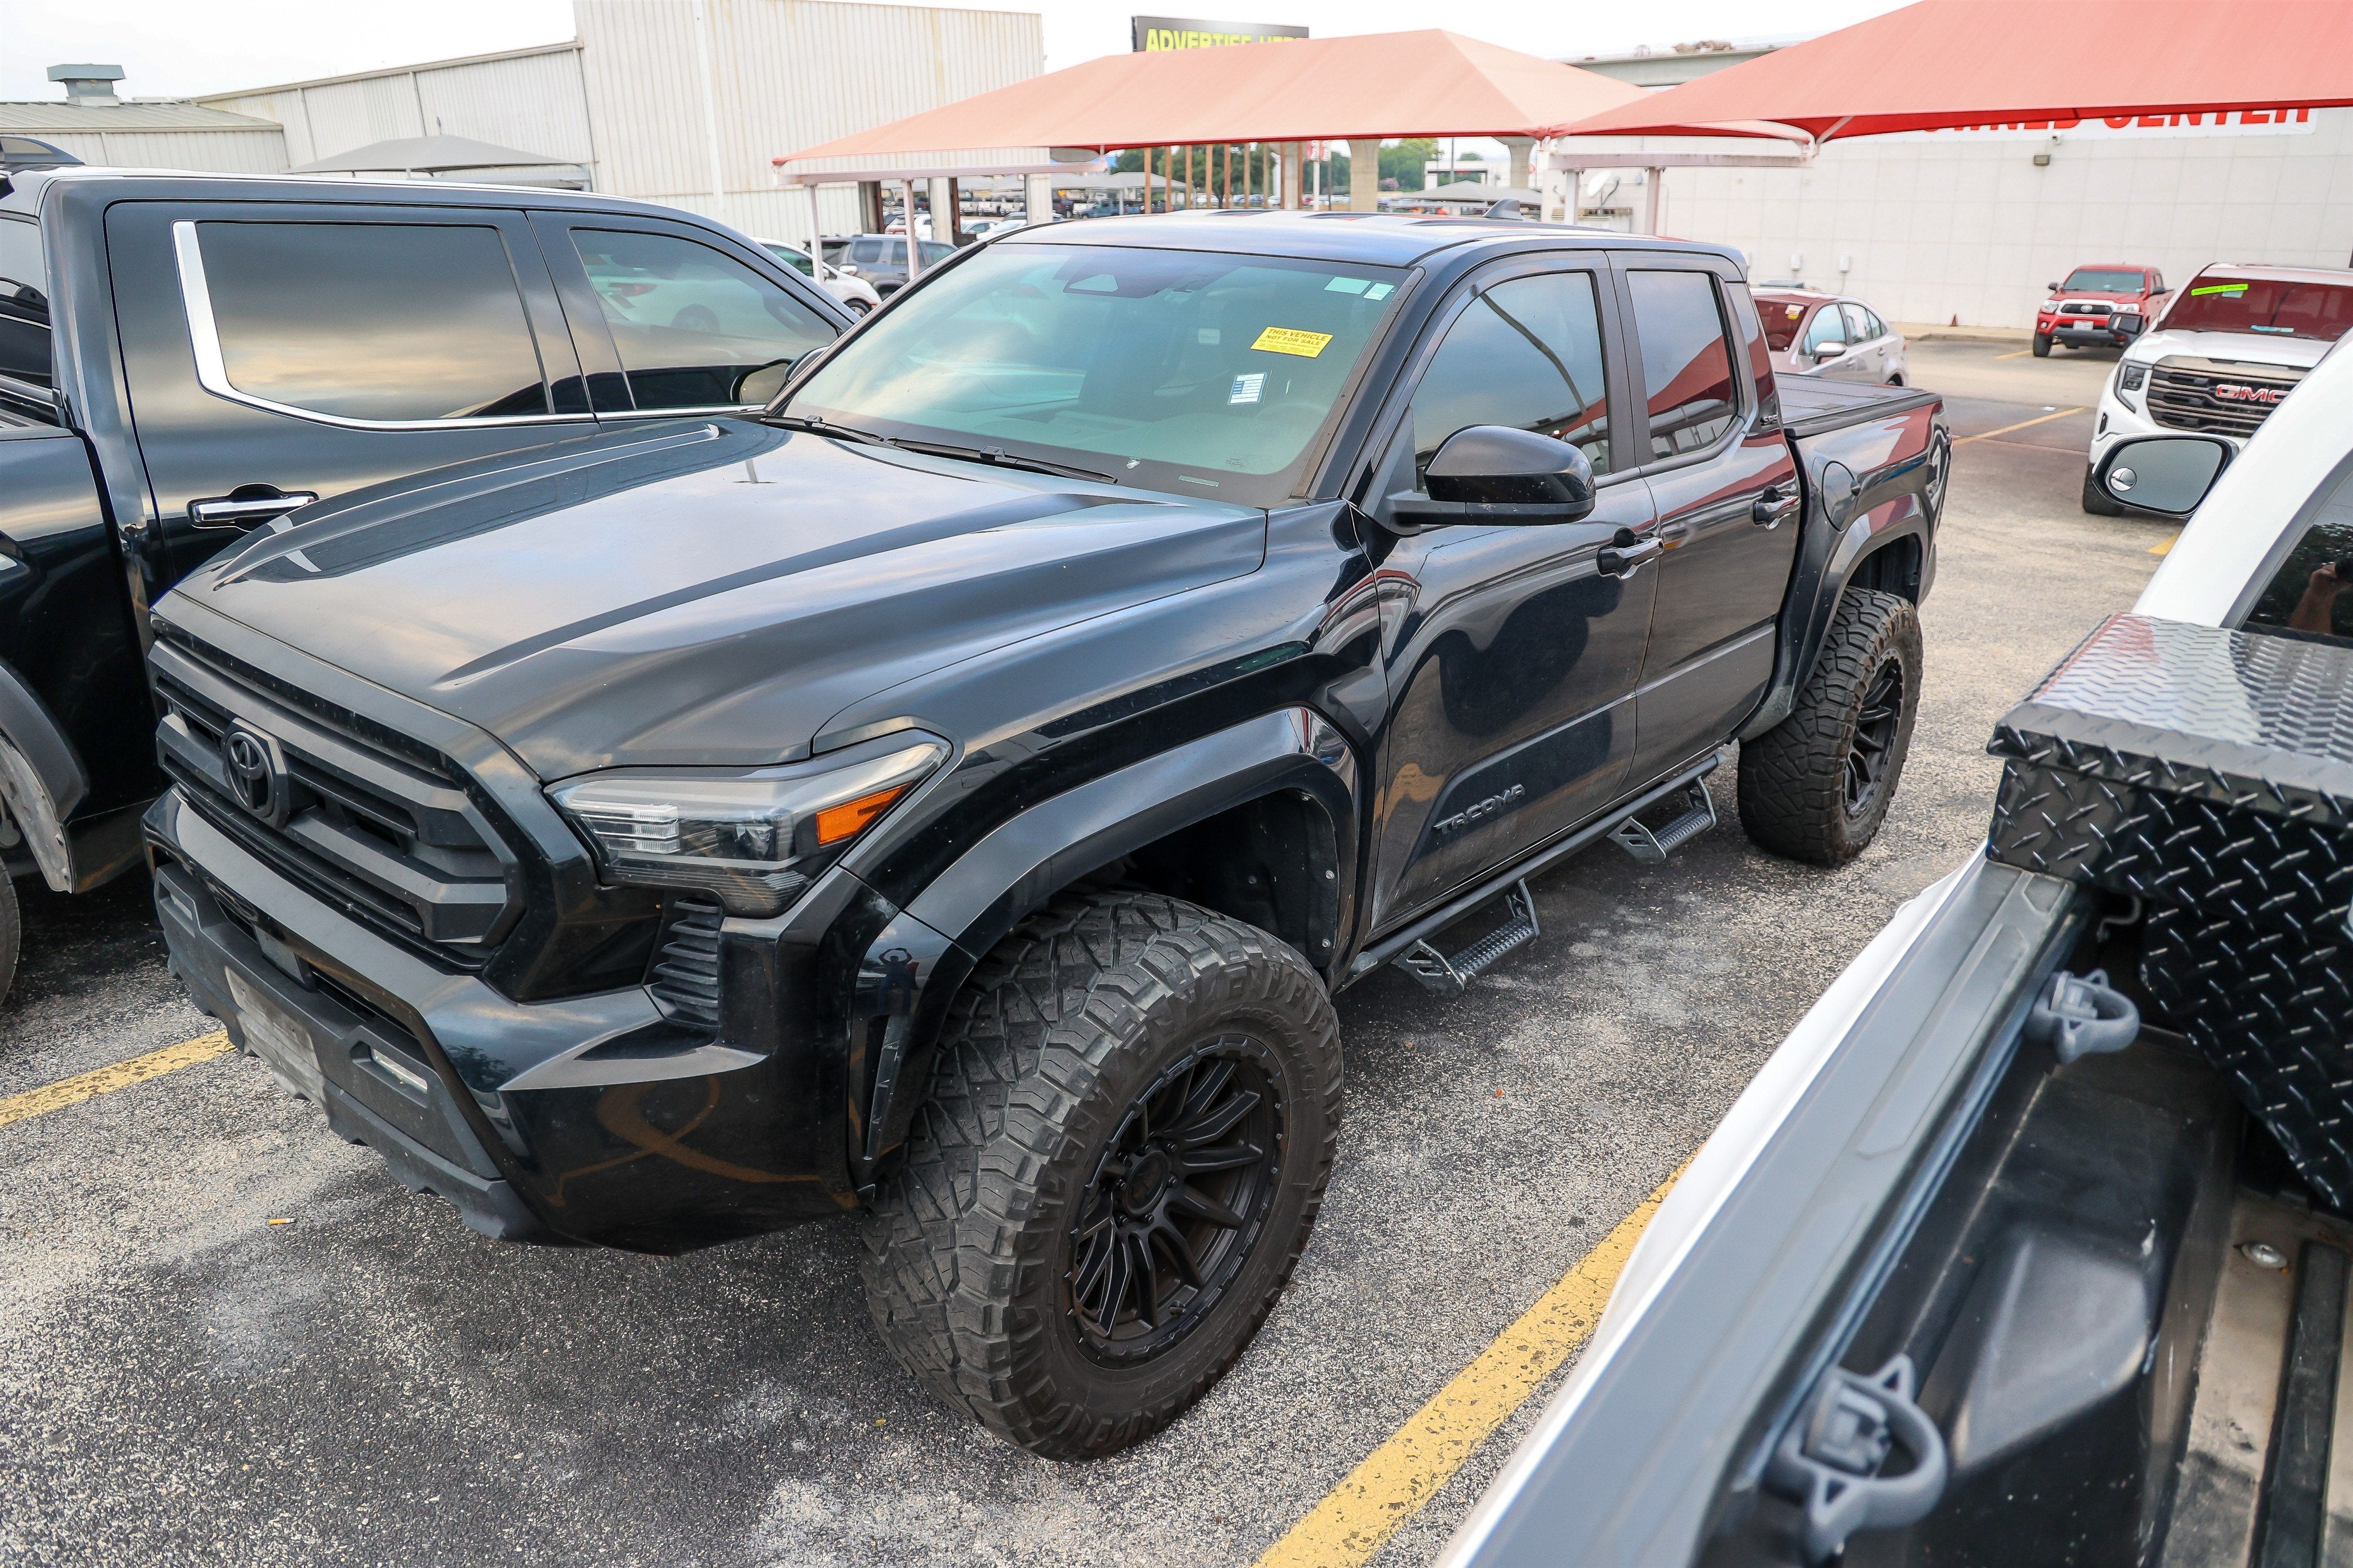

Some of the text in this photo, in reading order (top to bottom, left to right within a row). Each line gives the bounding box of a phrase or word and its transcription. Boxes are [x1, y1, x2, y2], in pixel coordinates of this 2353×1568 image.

[1290, 331, 1328, 341] VEHICLE
[2215, 384, 2291, 403] GMC
[1433, 783, 1526, 834] TACOMA
